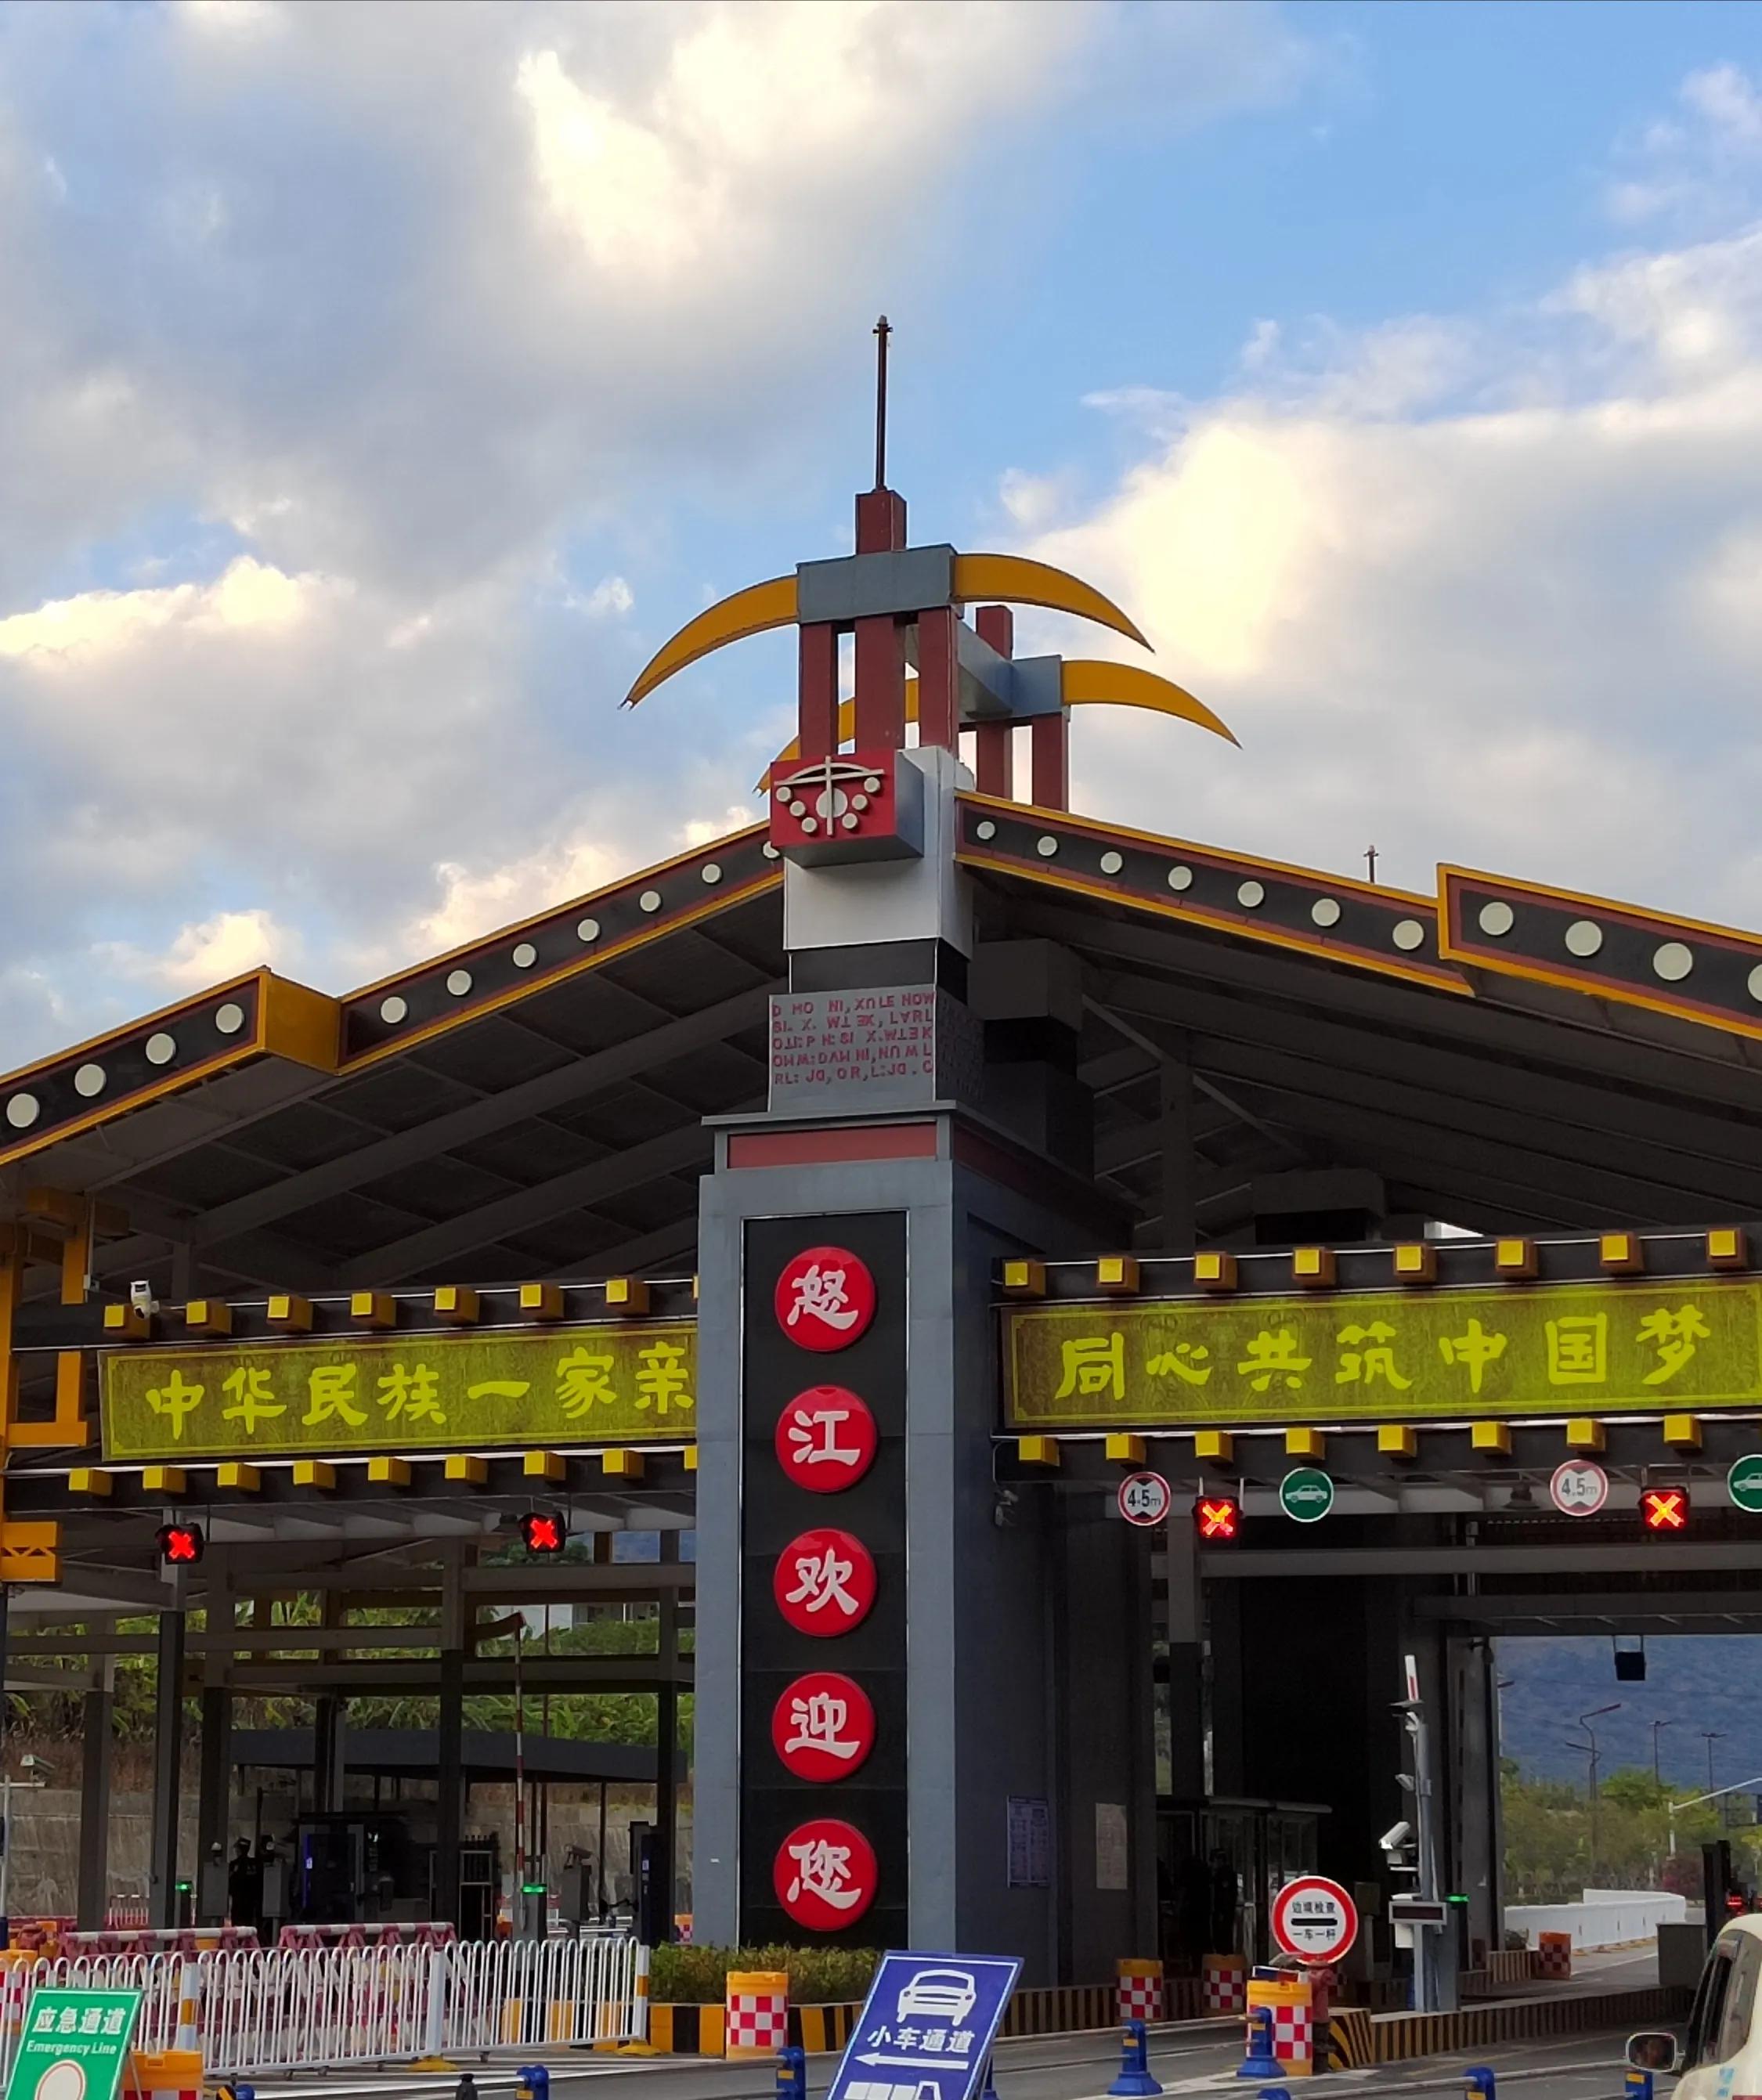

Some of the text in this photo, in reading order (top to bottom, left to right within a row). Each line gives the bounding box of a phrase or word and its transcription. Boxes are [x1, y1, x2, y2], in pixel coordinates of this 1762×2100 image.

[1055, 1304, 1711, 1402] 同心共筑中国梦
[146, 1341, 695, 1440] 中华民族一家亲
[1127, 1488, 1161, 1507] 4.5m
[1561, 1478, 1598, 1497] 4.5m
[784, 1265, 861, 1911] 怒江欢迎您
[32, 2006, 126, 2035] 应急通道
[26, 2040, 117, 2057] Emergency Line
[867, 2025, 975, 2053] 小车通道
